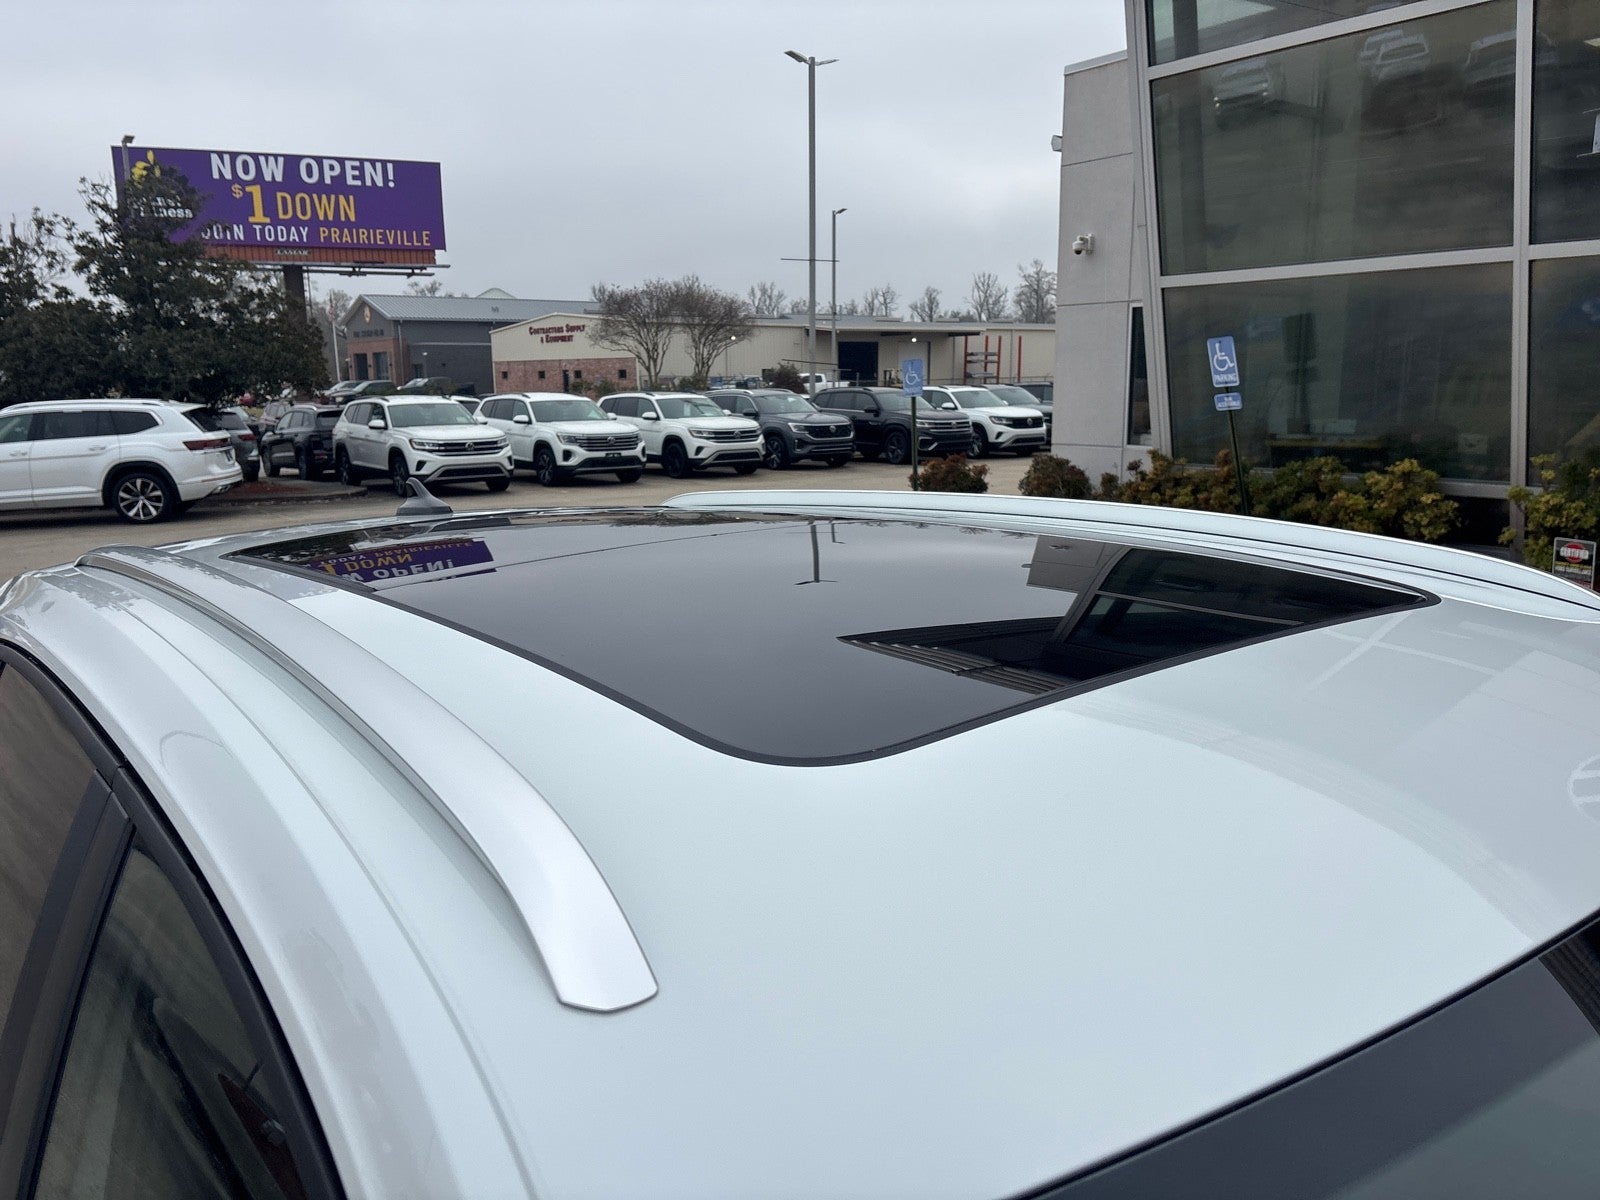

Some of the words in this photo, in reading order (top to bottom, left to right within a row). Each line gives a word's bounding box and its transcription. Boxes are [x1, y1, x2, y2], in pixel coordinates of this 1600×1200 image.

[210, 152, 285, 183] NOW
[299, 157, 397, 189] OPEN!
[276, 191, 357, 222] DOWN
[252, 224, 309, 243] TODAY
[319, 226, 431, 247] PRAIRIEVILLE
